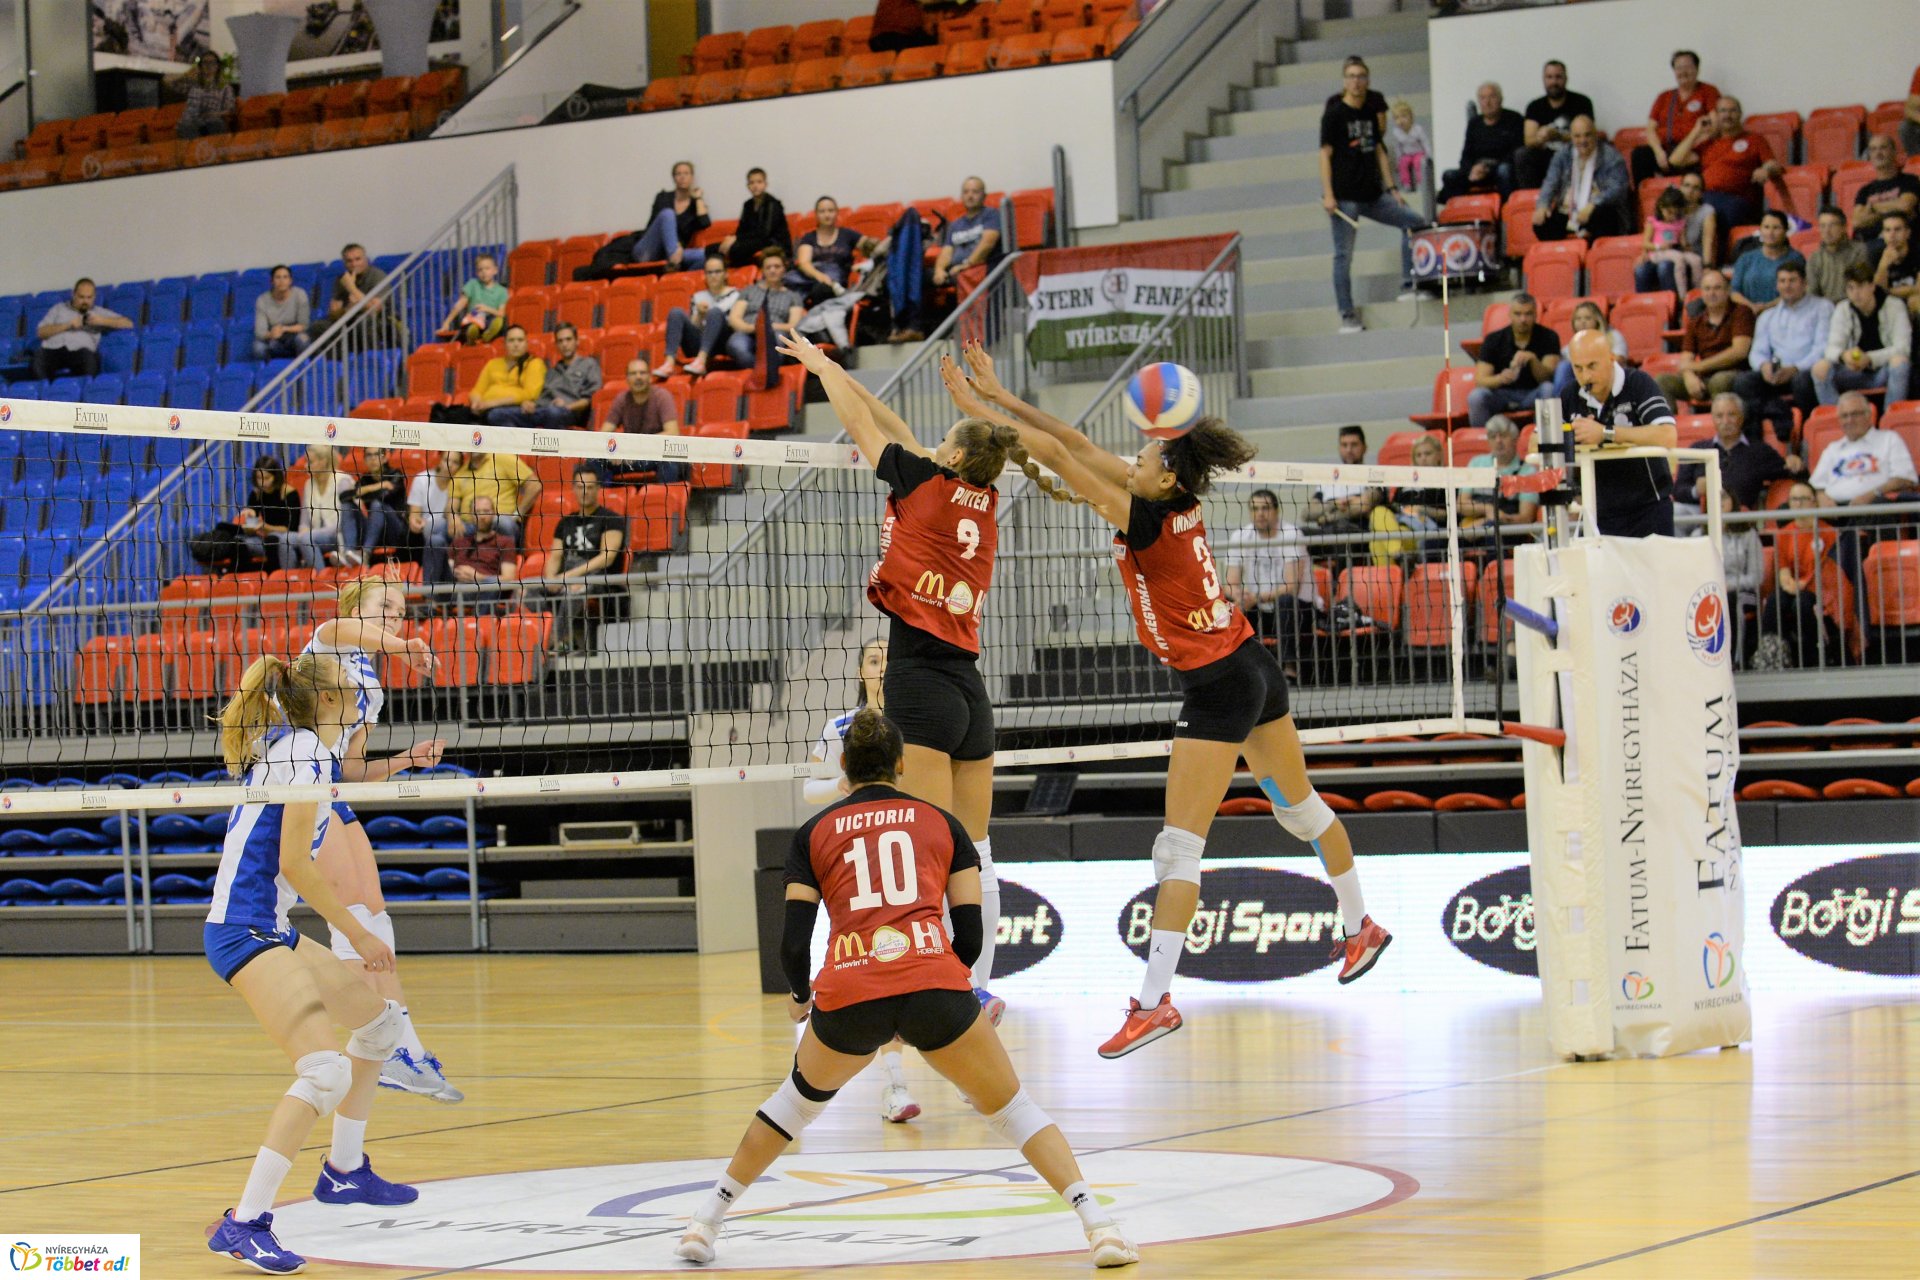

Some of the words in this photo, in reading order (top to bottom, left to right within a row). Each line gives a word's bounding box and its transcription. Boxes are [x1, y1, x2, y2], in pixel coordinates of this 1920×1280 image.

[957, 519, 980, 560] 9
[1193, 536, 1220, 600] 3
[835, 807, 915, 835] VICTORIA
[1694, 694, 1727, 898] FATUM
[843, 830, 918, 912] 10
